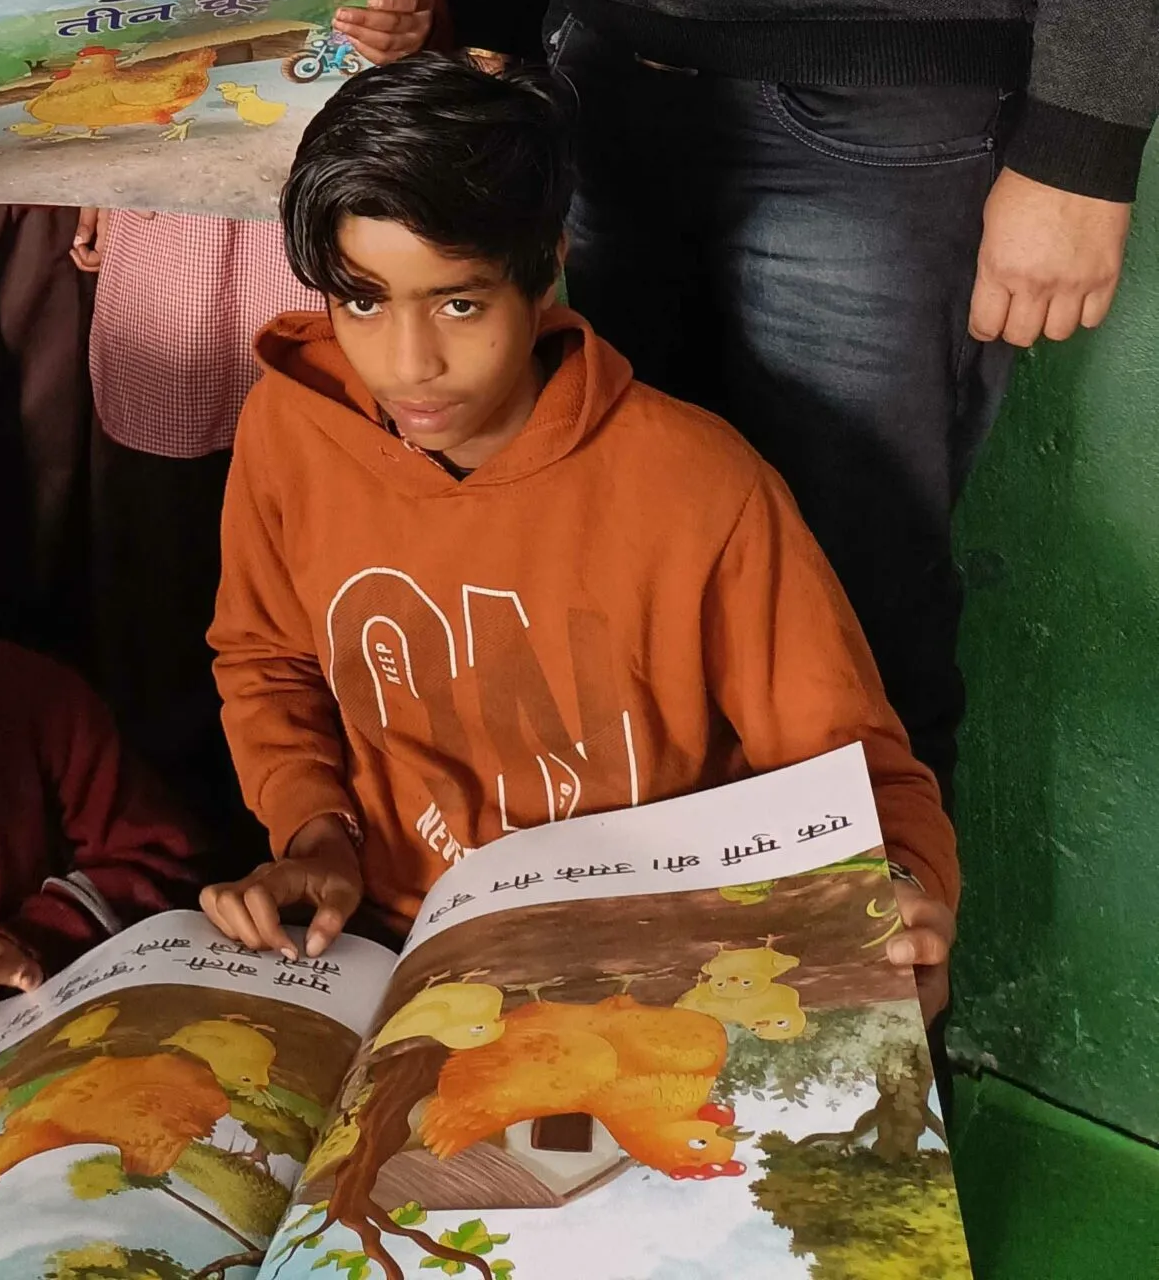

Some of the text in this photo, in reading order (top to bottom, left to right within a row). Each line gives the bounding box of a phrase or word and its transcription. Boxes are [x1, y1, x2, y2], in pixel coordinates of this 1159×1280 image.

[55, 1, 177, 38] तीन
[375, 642, 402, 685] KEEP
[796, 814, 853, 844] एक
[653, 851, 700, 872] थी।
[720, 832, 782, 866] मुर्गी
[490, 871, 544, 894] तीन
[553, 861, 637, 883] उसके
[272, 971, 332, 996] मुर्गी
